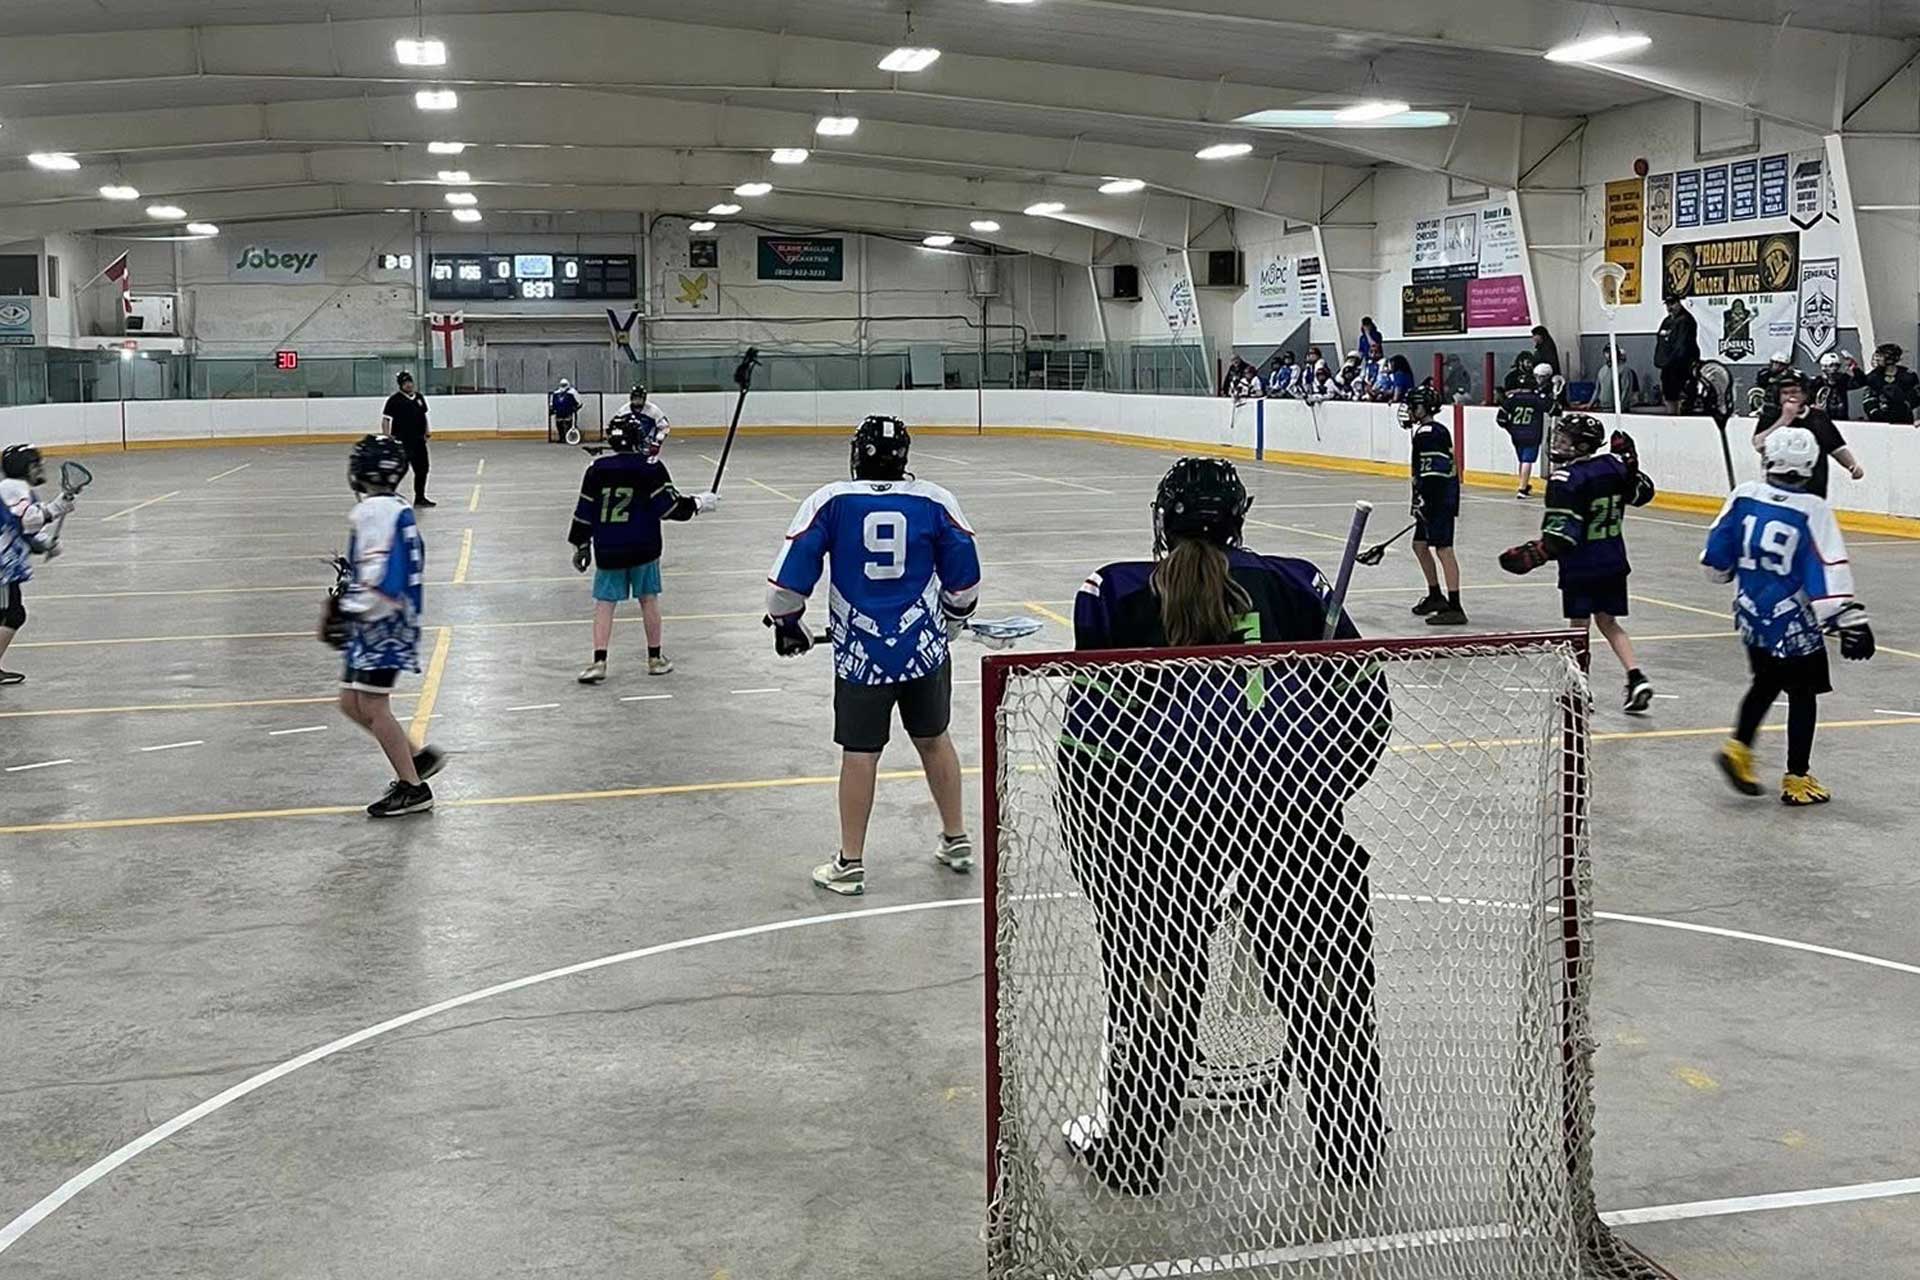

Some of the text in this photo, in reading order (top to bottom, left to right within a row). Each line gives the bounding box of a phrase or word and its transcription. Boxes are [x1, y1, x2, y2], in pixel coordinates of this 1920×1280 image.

[236, 247, 318, 274] Sobeys
[1695, 240, 1758, 266] THORBURN
[498, 261, 511, 278] 0
[565, 261, 578, 278] 0
[1694, 268, 1760, 294] GOLDEN HAWKS
[1749, 295, 1758, 304] OF
[1760, 294, 1773, 304] THE
[278, 353, 296, 368] 30
[1513, 406, 1534, 425] 26
[600, 487, 634, 522] 12
[863, 511, 907, 581] 9
[1736, 514, 1799, 577] 19
